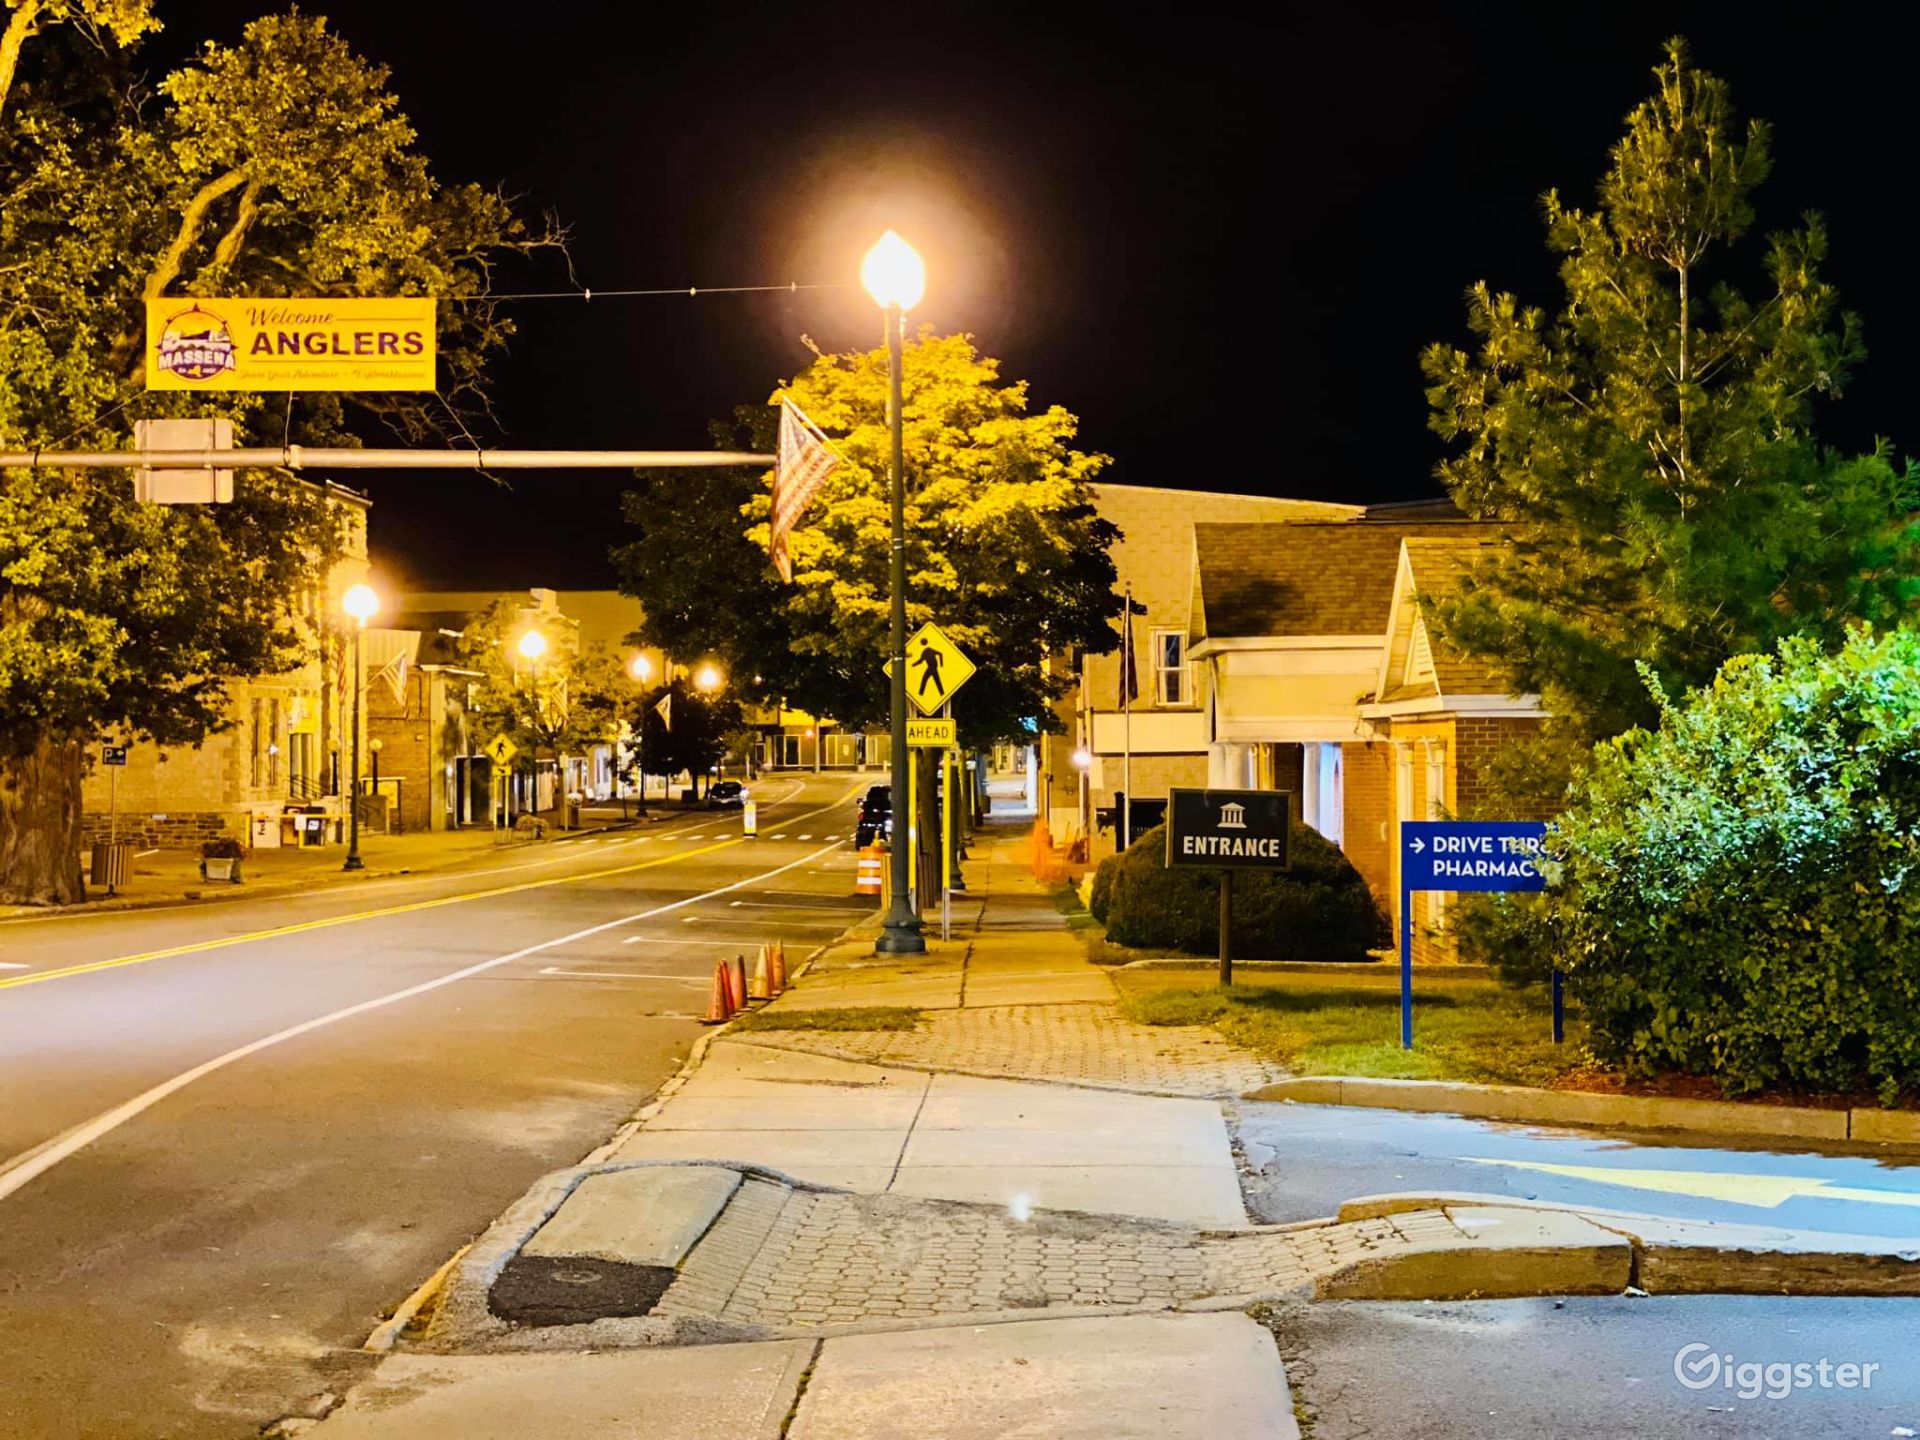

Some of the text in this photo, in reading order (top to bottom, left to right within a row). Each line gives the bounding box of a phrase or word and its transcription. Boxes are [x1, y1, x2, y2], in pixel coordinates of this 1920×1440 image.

[246, 306, 334, 327] Welcome
[250, 331, 424, 356] ANGLERS
[158, 349, 236, 371] MASSENA
[908, 727, 949, 739] AHEAD
[1182, 835, 1280, 858] ENTRANCE
[1433, 836, 1493, 853] DRIVE
[1433, 860, 1544, 877] PHARMAC
